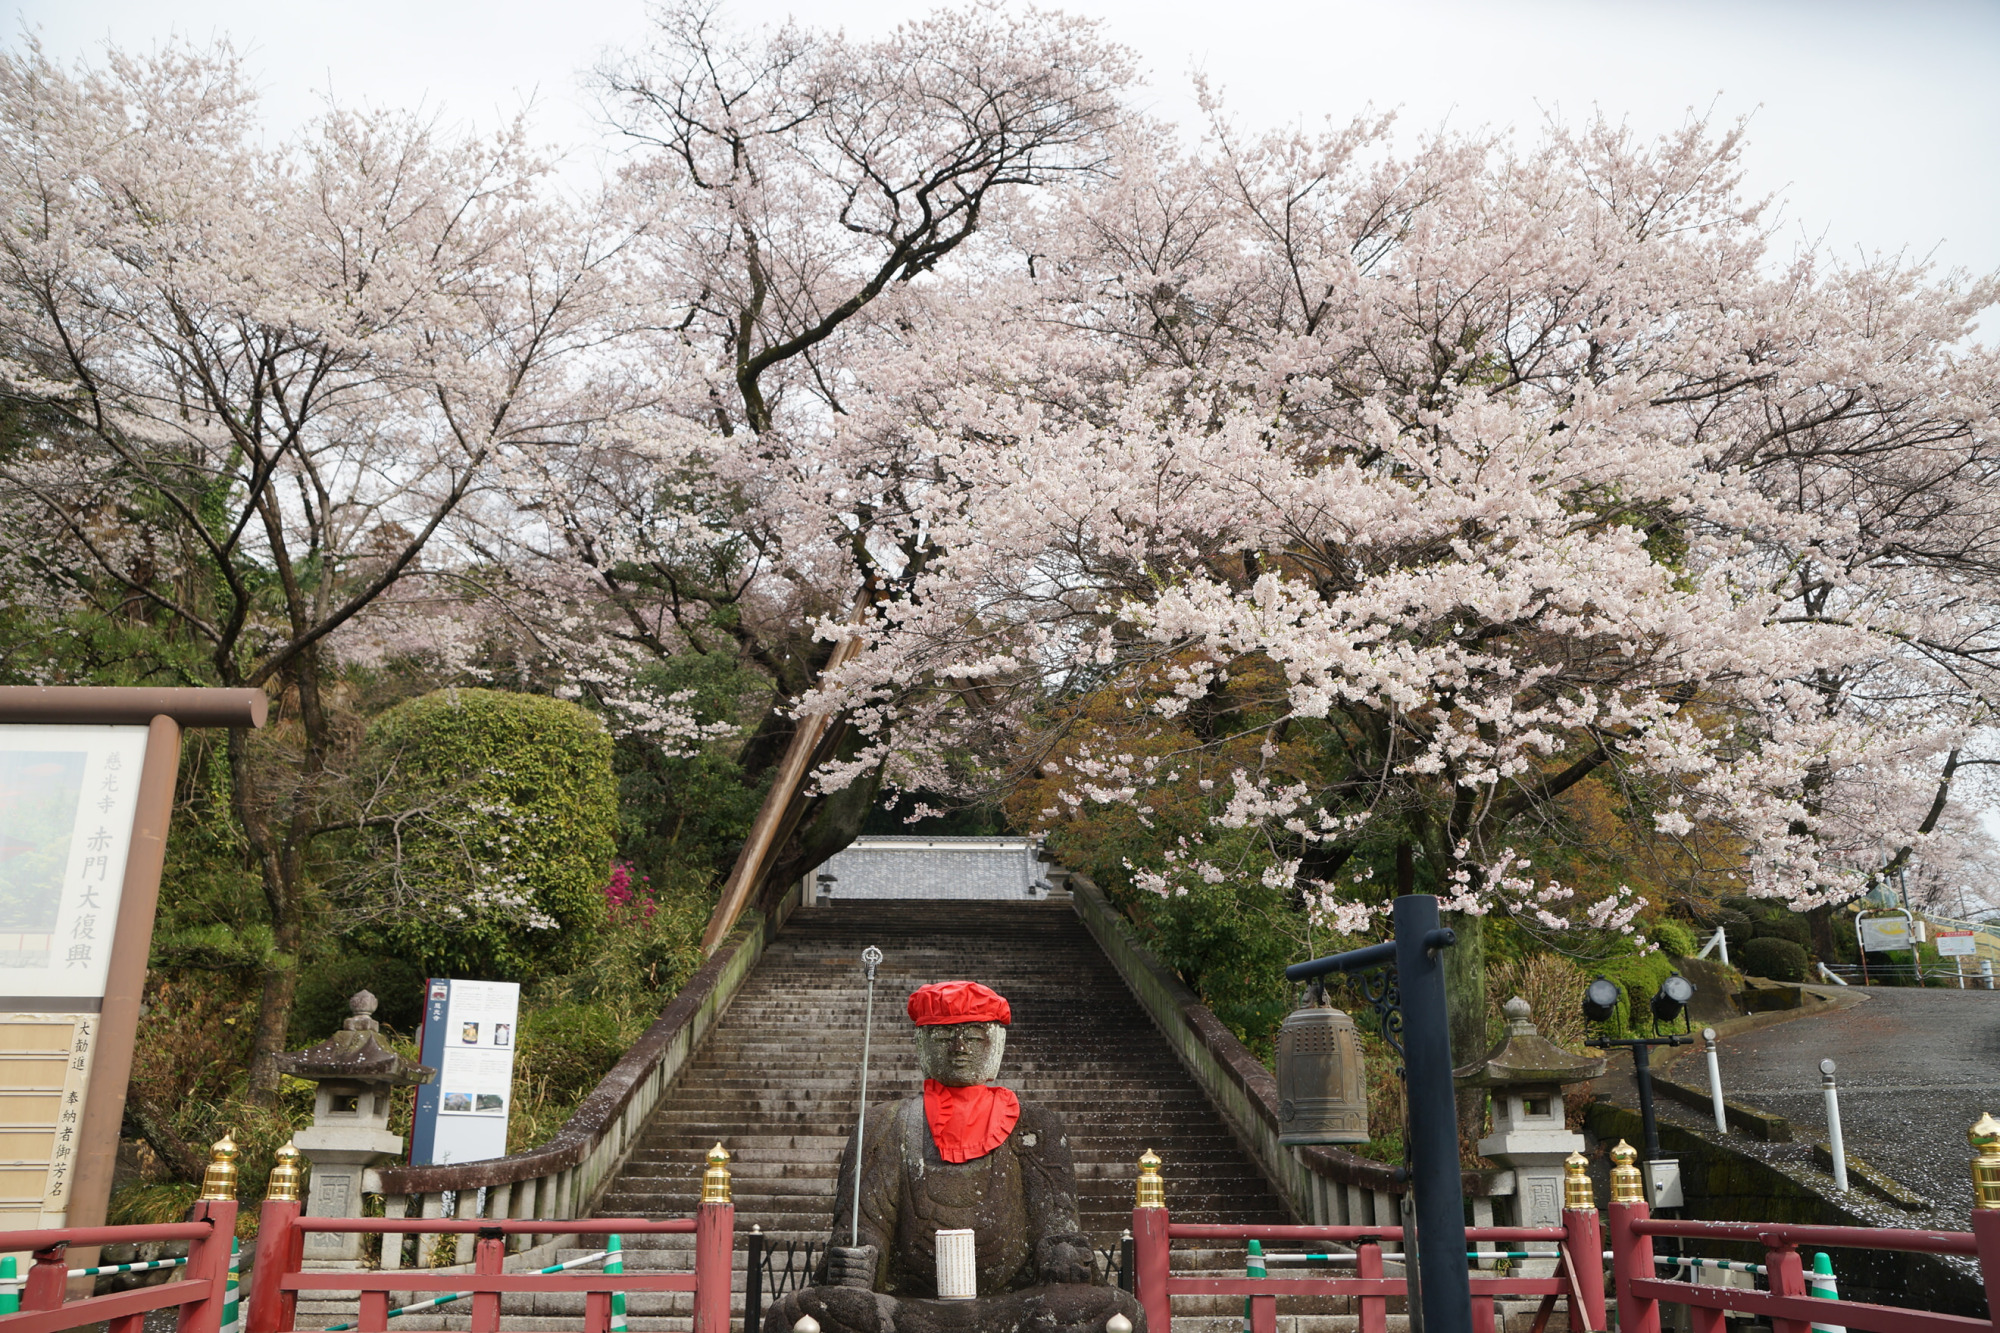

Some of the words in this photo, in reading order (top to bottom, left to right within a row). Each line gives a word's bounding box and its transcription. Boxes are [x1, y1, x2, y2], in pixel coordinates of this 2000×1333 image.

[96, 751, 123, 815] 慈光寺
[64, 825, 114, 970] 赤門大復興
[49, 1090, 79, 1198] 奉納者御芳名
